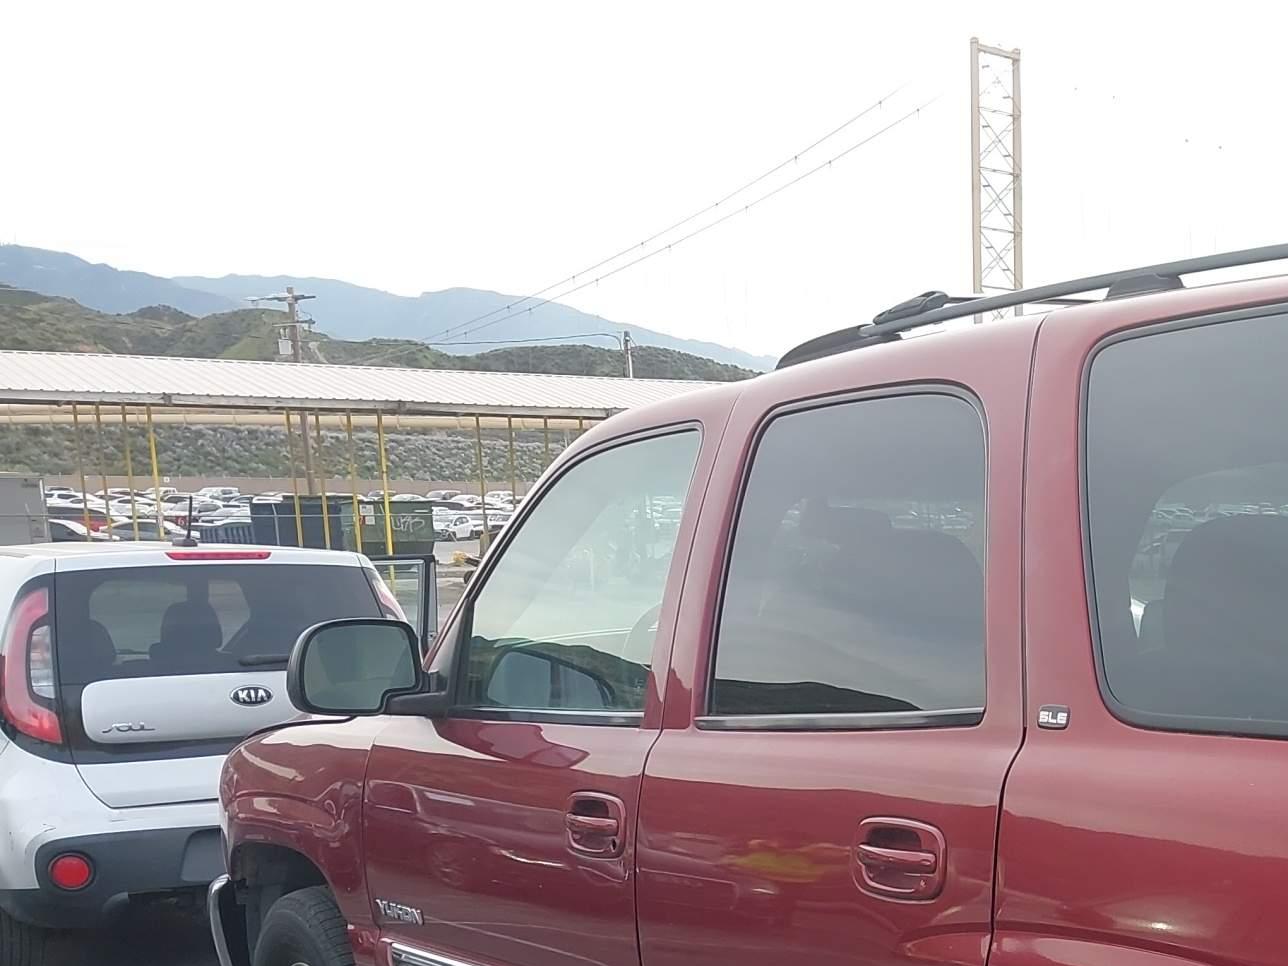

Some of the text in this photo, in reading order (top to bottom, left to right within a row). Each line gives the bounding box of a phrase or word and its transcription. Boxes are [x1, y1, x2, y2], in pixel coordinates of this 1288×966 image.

[237, 690, 267, 702] KIA
[1039, 710, 1067, 724] SLE
[376, 899, 422, 925] YUKON
